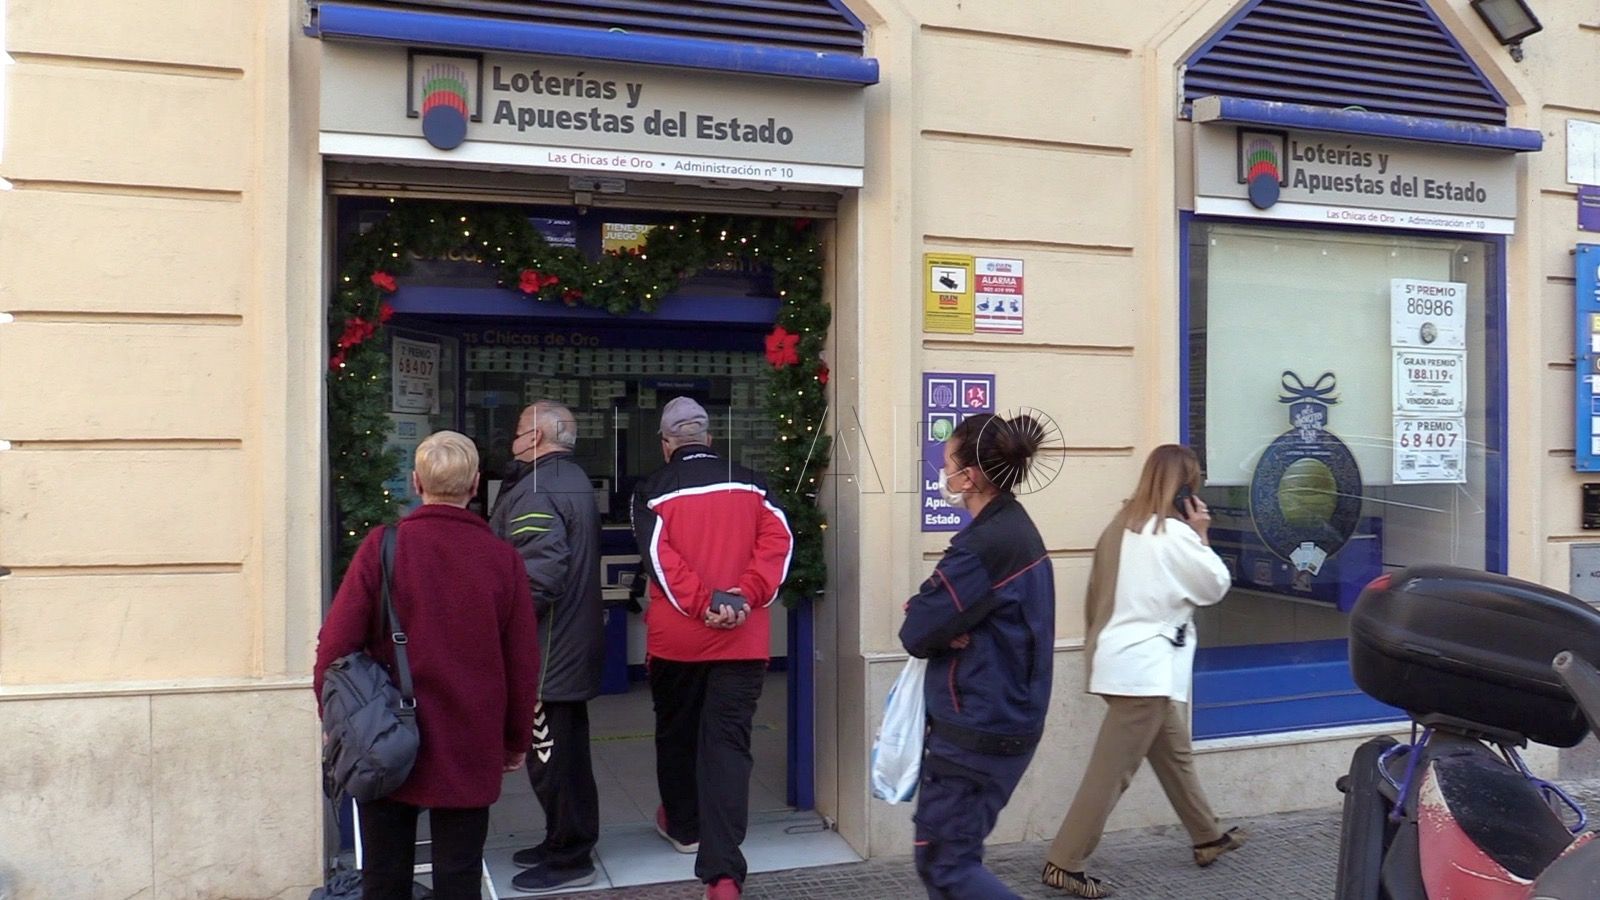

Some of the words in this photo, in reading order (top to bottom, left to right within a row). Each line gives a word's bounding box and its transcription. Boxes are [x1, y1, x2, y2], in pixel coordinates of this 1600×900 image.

[492, 66, 617, 100] Loterías
[626, 83, 642, 109] y
[493, 99, 635, 134] Apuestas
[643, 109, 687, 138] del
[696, 114, 794, 146] Estado
[547, 152, 567, 164] Las
[570, 153, 609, 167] Chicas
[611, 156, 628, 168] de
[630, 157, 653, 169] Oro
[674, 160, 761, 177] Administración
[781, 168, 794, 178] 10
[1292, 141, 1373, 168] Loterías
[1378, 153, 1389, 175] y
[1293, 168, 1385, 194] Apuestas
[1390, 174, 1418, 198] del
[1424, 179, 1487, 204] Estado
[605, 223, 635, 233] TIENE
[1326, 210, 1340, 219] Las
[1341, 210, 1366, 221] Chicas
[1368, 213, 1378, 222] de
[1380, 213, 1396, 223] Oro
[1408, 215, 1464, 228] Administración
[604, 232, 638, 240] JUEGO
[980, 276, 1017, 286] ALARMA
[1417, 285, 1456, 297] PREMIO
[1407, 297, 1453, 317] 86986
[483, 328, 540, 345] Chicas
[544, 331, 565, 345] de
[570, 332, 600, 347] Oro
[399, 358, 434, 376] 68407
[1403, 357, 1426, 366] GRAN
[1427, 358, 1457, 367] PREMIO
[1417, 421, 1453, 431] PREMIO
[1400, 432, 1458, 448] 68407
[925, 513, 961, 525] Estado
